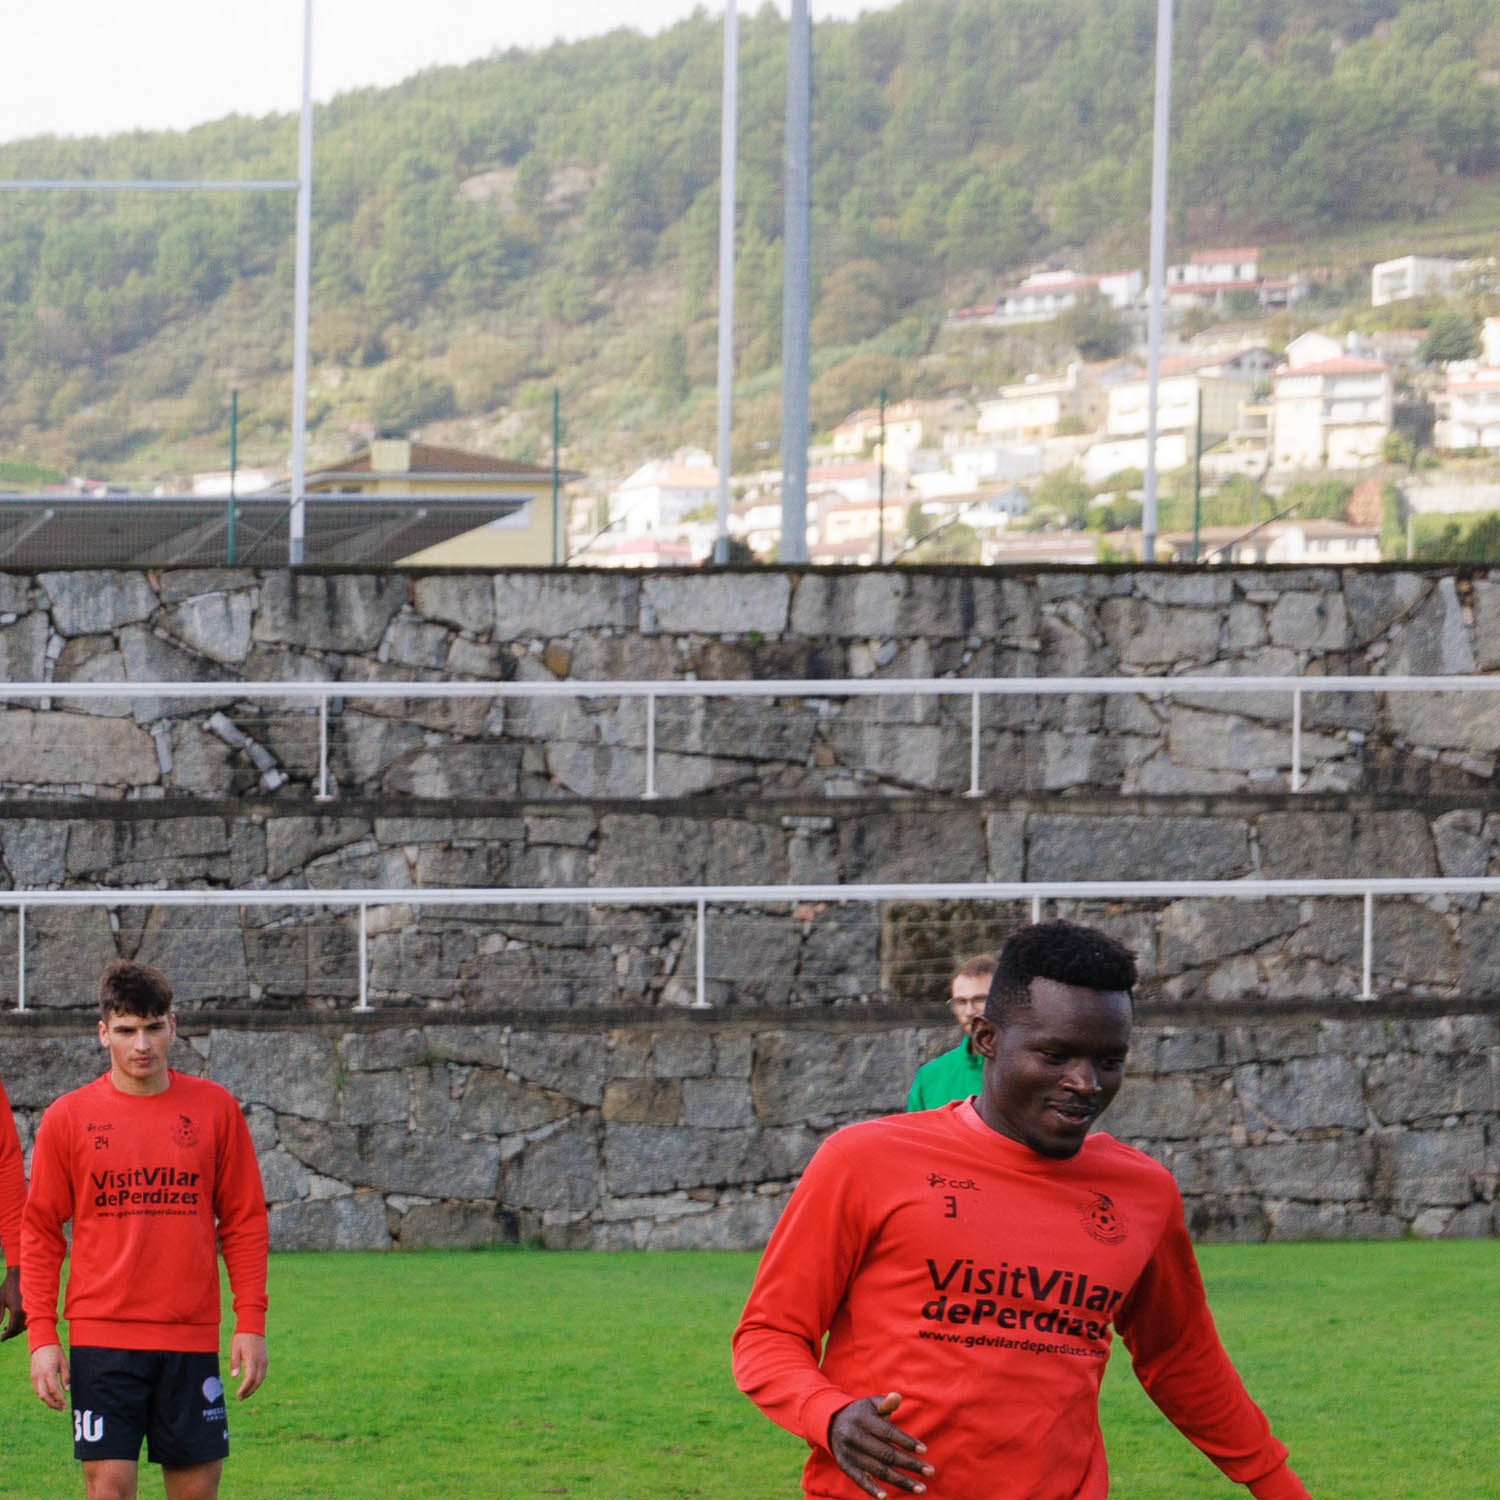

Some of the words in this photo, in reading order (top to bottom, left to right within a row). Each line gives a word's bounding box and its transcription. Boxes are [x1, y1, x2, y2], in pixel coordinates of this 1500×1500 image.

[95, 1135, 109, 1150] 24
[91, 1166, 200, 1189] VisitVilar
[950, 1178, 980, 1191] cdt
[95, 1188, 198, 1207] dePerdizes
[944, 1196, 958, 1218] 3
[926, 1258, 1123, 1313] VisitVilar
